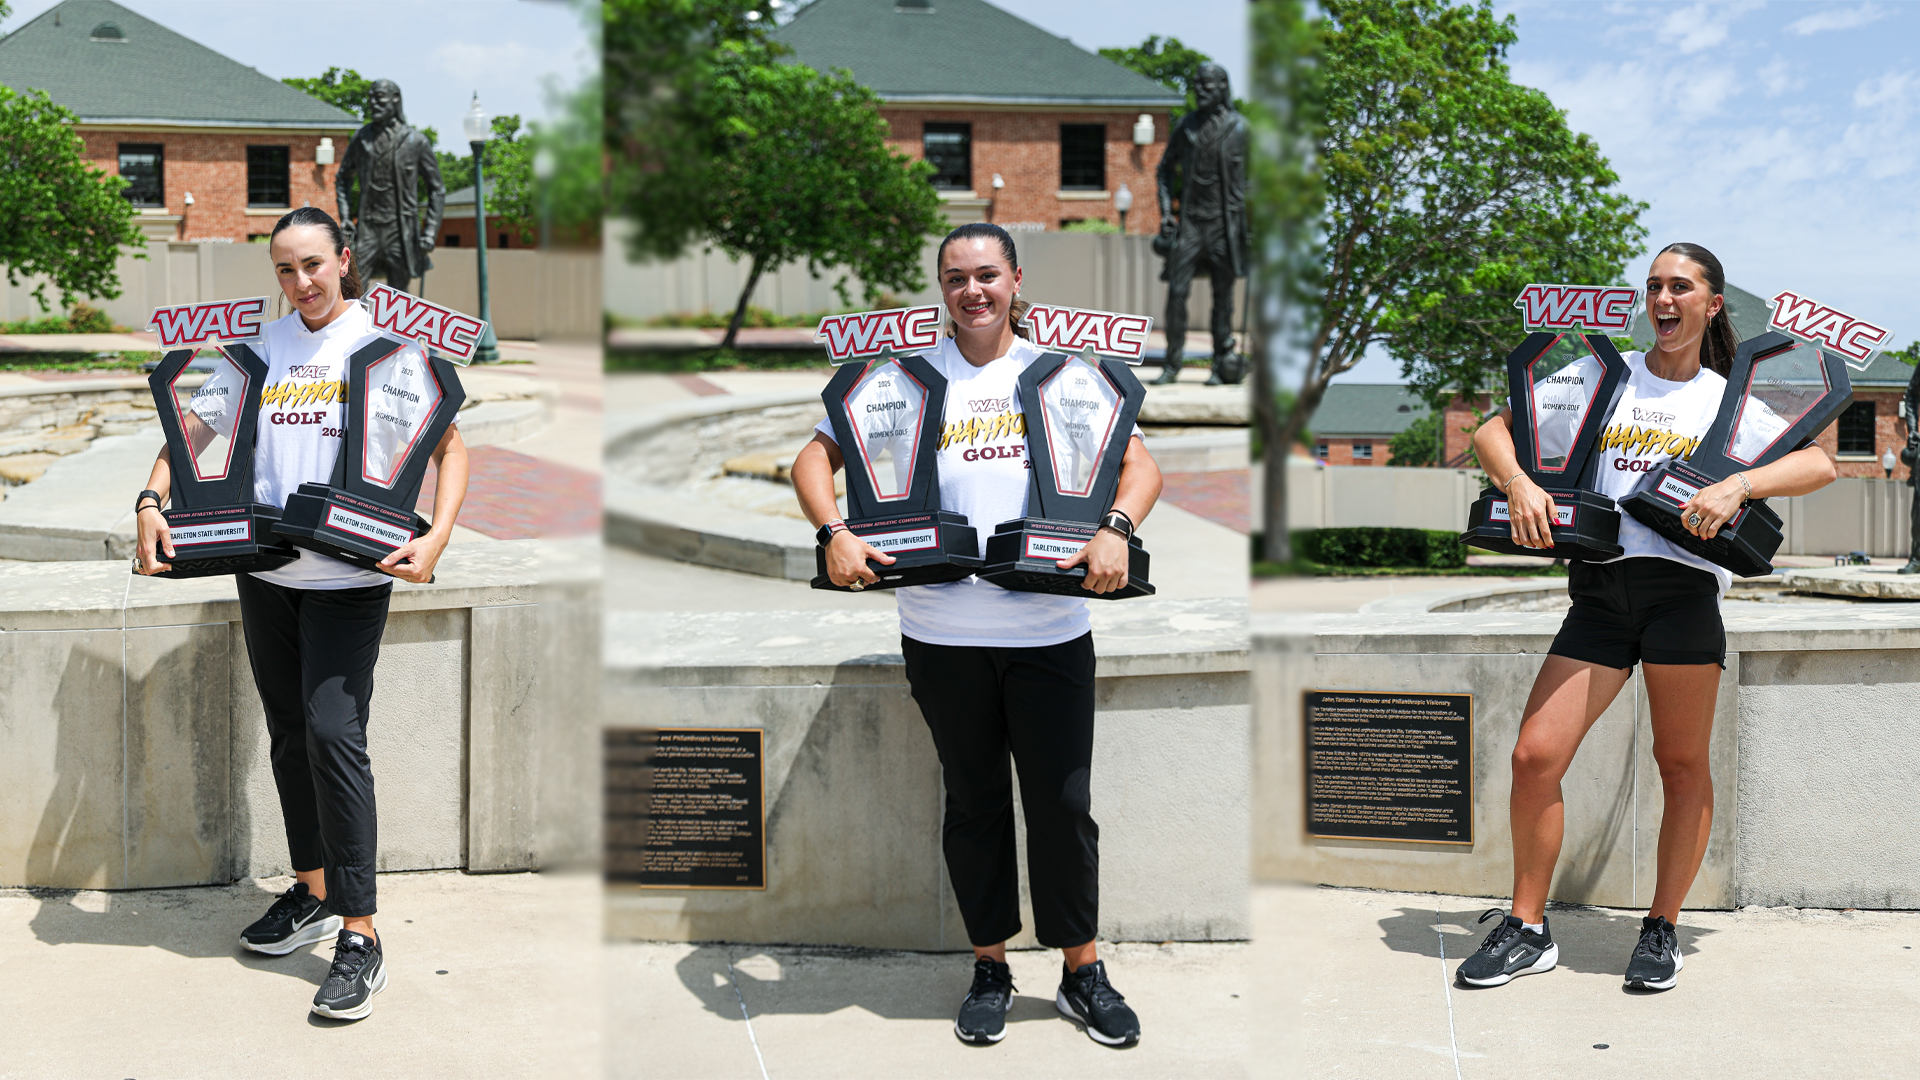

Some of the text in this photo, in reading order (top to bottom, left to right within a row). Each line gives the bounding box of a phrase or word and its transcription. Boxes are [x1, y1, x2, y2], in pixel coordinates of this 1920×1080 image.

[1519, 286, 1638, 331] WAC
[150, 298, 265, 347] WAC
[366, 284, 484, 360] WAC
[1772, 291, 1889, 362] WAC
[818, 306, 940, 360] WAC
[1024, 306, 1149, 359] WAC
[289, 366, 330, 378] WAC
[1547, 376, 1585, 385] CHAMPION
[1767, 376, 1806, 397] CHAMPION
[191, 387, 229, 399] CHAMPION
[382, 384, 420, 404] CHAMPION
[866, 401, 907, 413] CHAMPION
[968, 396, 1010, 413] WAC
[1060, 398, 1100, 410] CHAMPION
[1542, 403, 1567, 411] WOMEN'S
[198, 410, 223, 418] WOMEN'S
[271, 411, 327, 425] GOLF
[375, 411, 413, 429] WOMEN'S GOLF
[1632, 407, 1676, 427] WAC
[322, 427, 344, 438] 202
[1065, 423, 1091, 431] WOMEN'S
[868, 429, 908, 439] WOMEN'S GOLF
[1070, 431, 1084, 439] GOLF
[963, 445, 1025, 462] GOLF
[1614, 458, 1652, 472] GOL
[1676, 466, 1697, 478] WESTERN
[1665, 482, 1692, 500] TARLETON
[335, 494, 411, 522] WESTERN ATHLETIC CONFERENCE
[898, 516, 932, 524] CONFERENCE
[170, 532, 197, 540] TARLETON
[214, 528, 245, 536] UNIVERSITY
[333, 514, 407, 543] TARLETON STATE UNIVERSITY
[882, 539, 899, 547] STATE
[900, 535, 932, 545] UNIVERSITY
[1033, 544, 1061, 553] TARLETON
[1426, 699, 1451, 707] Visionary
